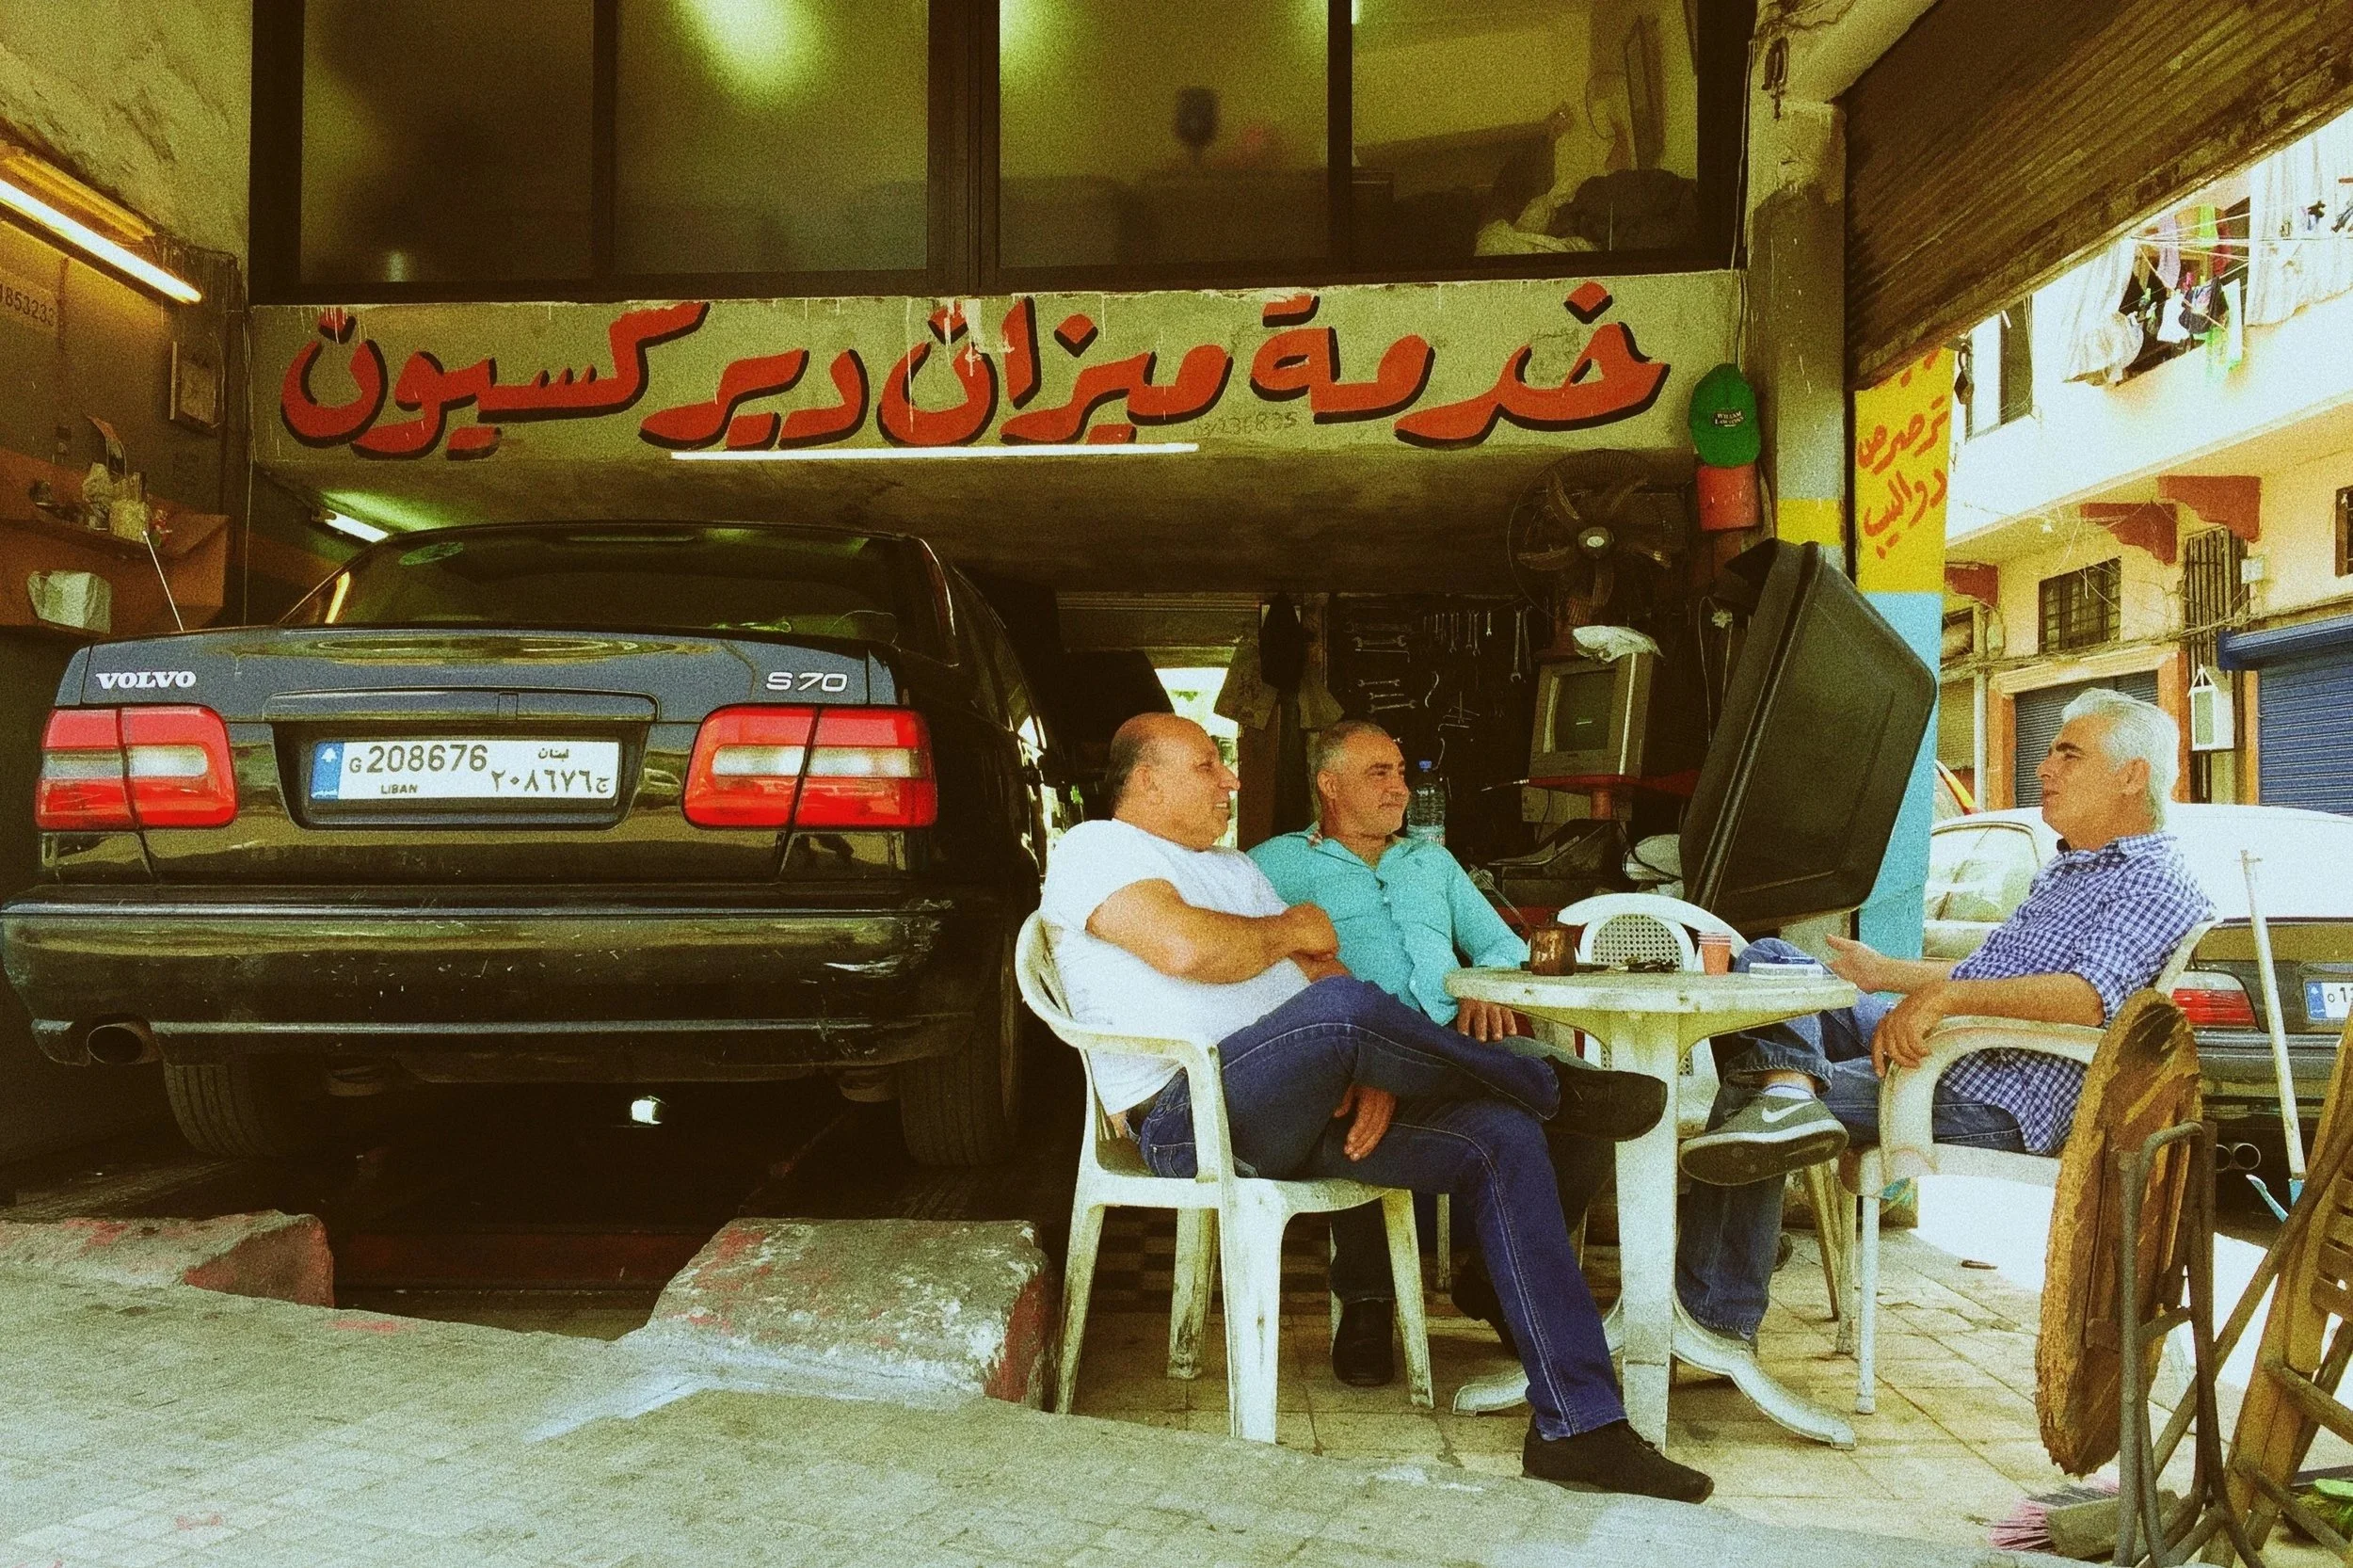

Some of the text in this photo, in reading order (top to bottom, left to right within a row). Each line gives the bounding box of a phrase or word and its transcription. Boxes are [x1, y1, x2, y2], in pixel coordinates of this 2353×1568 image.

[877, 296, 1233, 446] ميزان
[1864, 469, 1947, 559] دواليب
[95, 671, 197, 690] VOLVO
[349, 744, 488, 774] G 208676
[537, 747, 569, 762] لبنان
[380, 784, 418, 794] LIBAN
